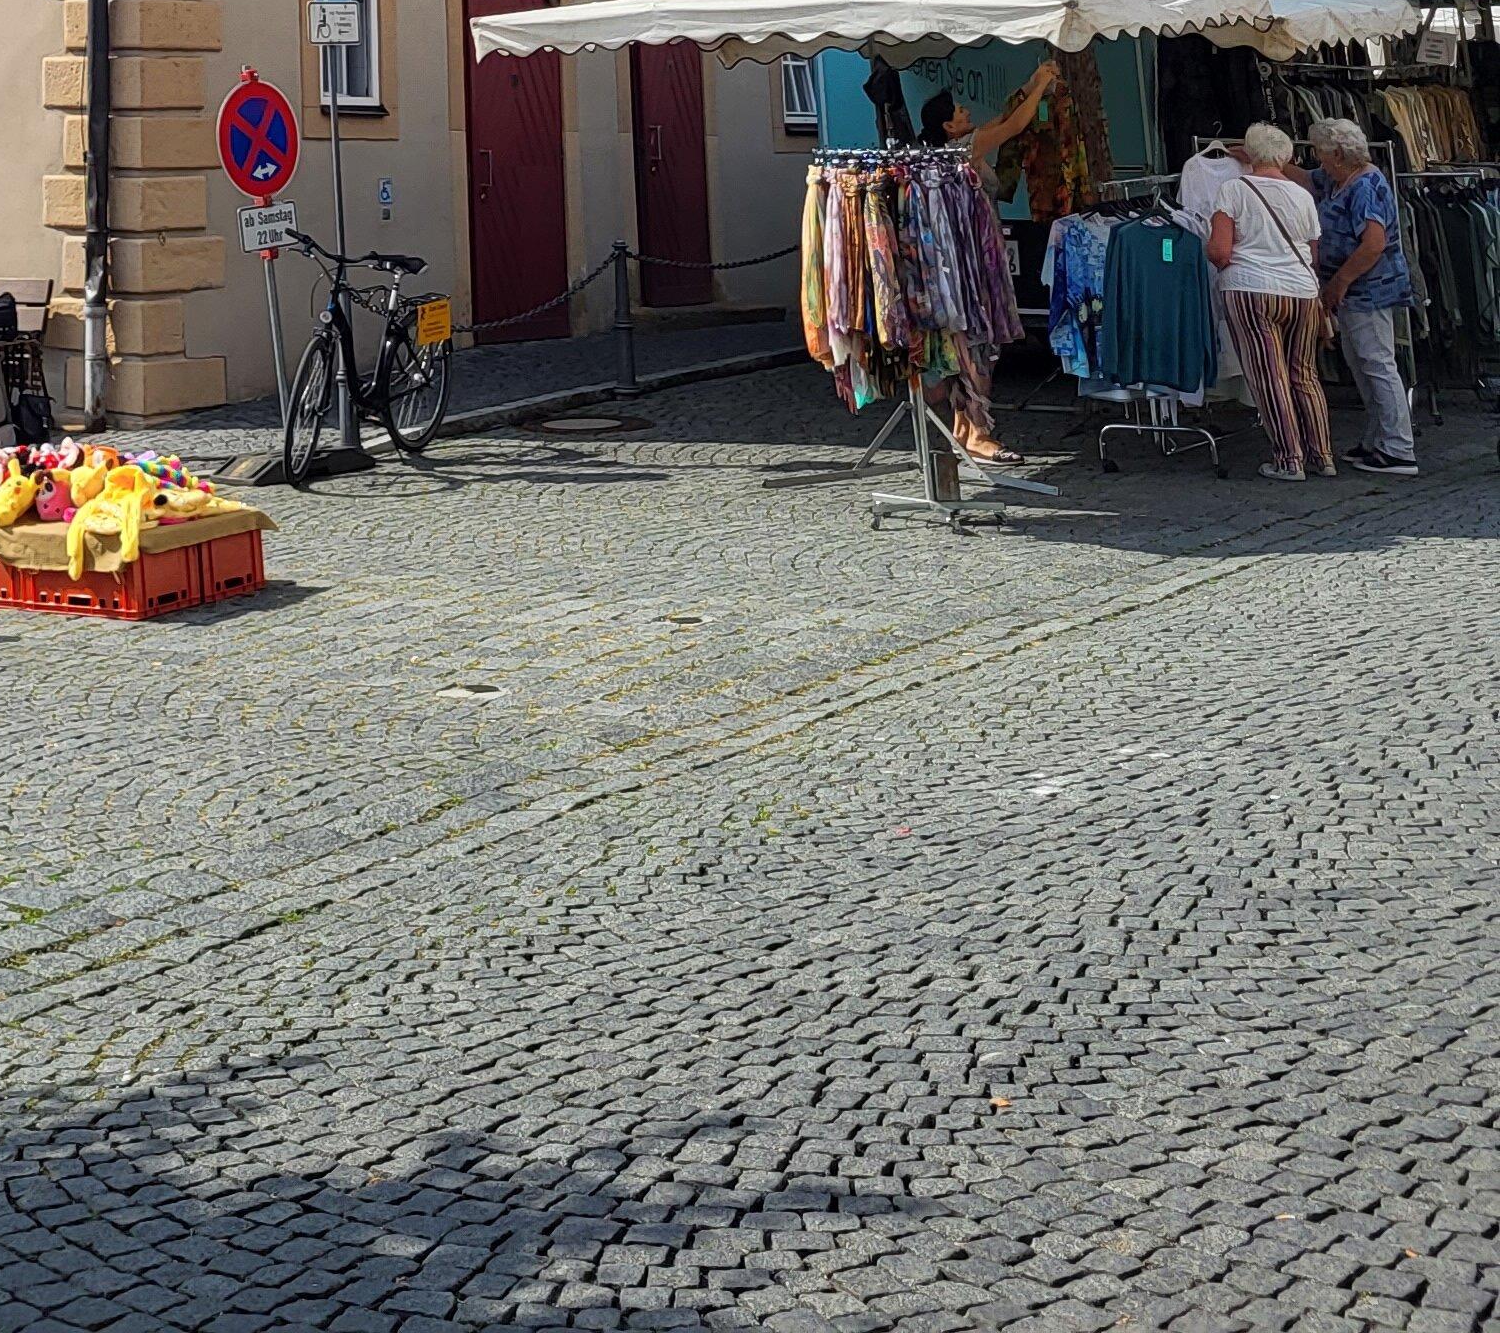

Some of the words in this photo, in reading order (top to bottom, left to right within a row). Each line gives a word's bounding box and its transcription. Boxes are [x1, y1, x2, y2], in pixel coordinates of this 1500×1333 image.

[244, 213, 255, 228] ab
[257, 209, 293, 225] Samstag
[257, 230, 268, 245] 22
[269, 229, 283, 243] Uhr
